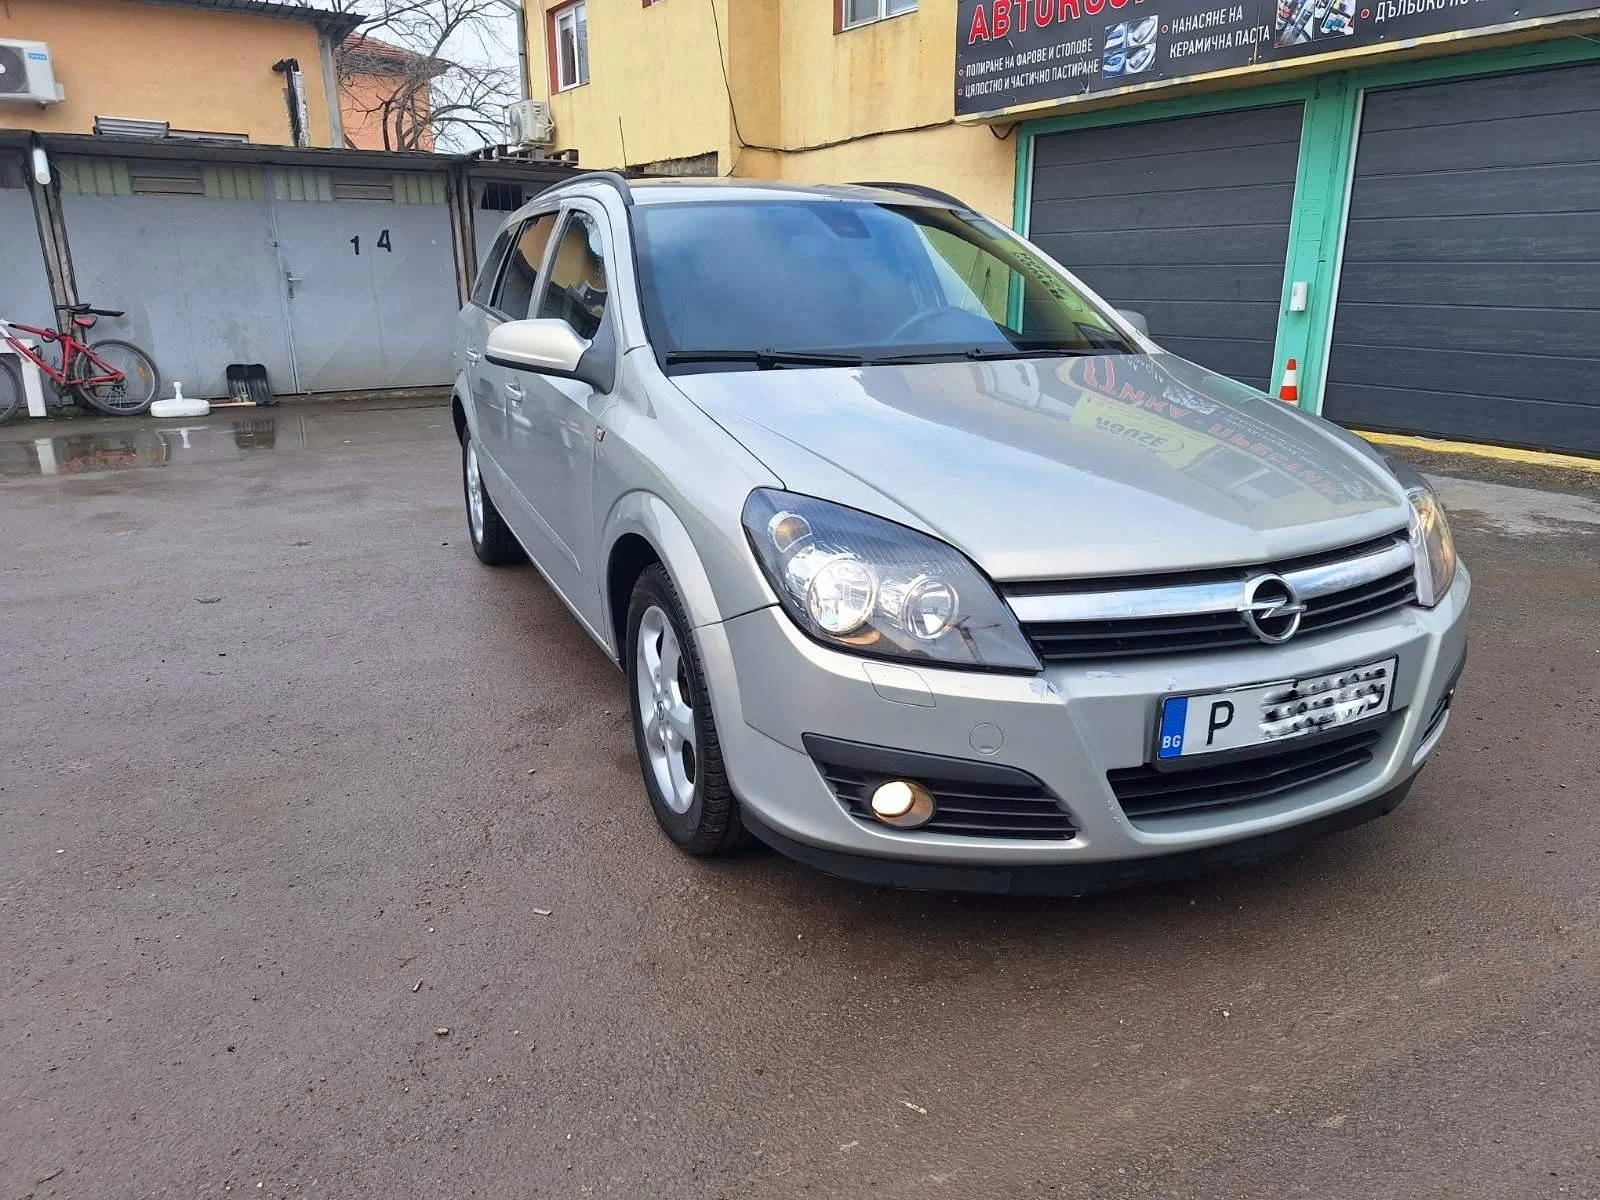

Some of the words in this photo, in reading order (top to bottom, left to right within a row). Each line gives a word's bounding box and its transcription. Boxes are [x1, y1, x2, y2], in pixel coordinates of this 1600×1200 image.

[968, 0, 1144, 44] АВТОК
[1172, 8, 1227, 34] НАНАСЯНЕ
[1229, 5, 1243, 23] НА
[1005, 55, 1015, 70] НА
[1016, 47, 1047, 67] ФАРОВЕ
[1048, 46, 1054, 60] И
[1056, 37, 1094, 58] СТОПОВЕ
[1170, 32, 1232, 59] КЕРАМИЧНА
[1235, 25, 1270, 47] ПАСТА
[965, 78, 1003, 99] ЦЯЛОСТНО
[1004, 77, 1011, 90] И
[1011, 68, 1050, 88] ЧАСТИЧНО
[1052, 58, 1100, 81] ПАСТИРАНЕ
[1206, 700, 1235, 746] P
[1161, 734, 1182, 748] BG
